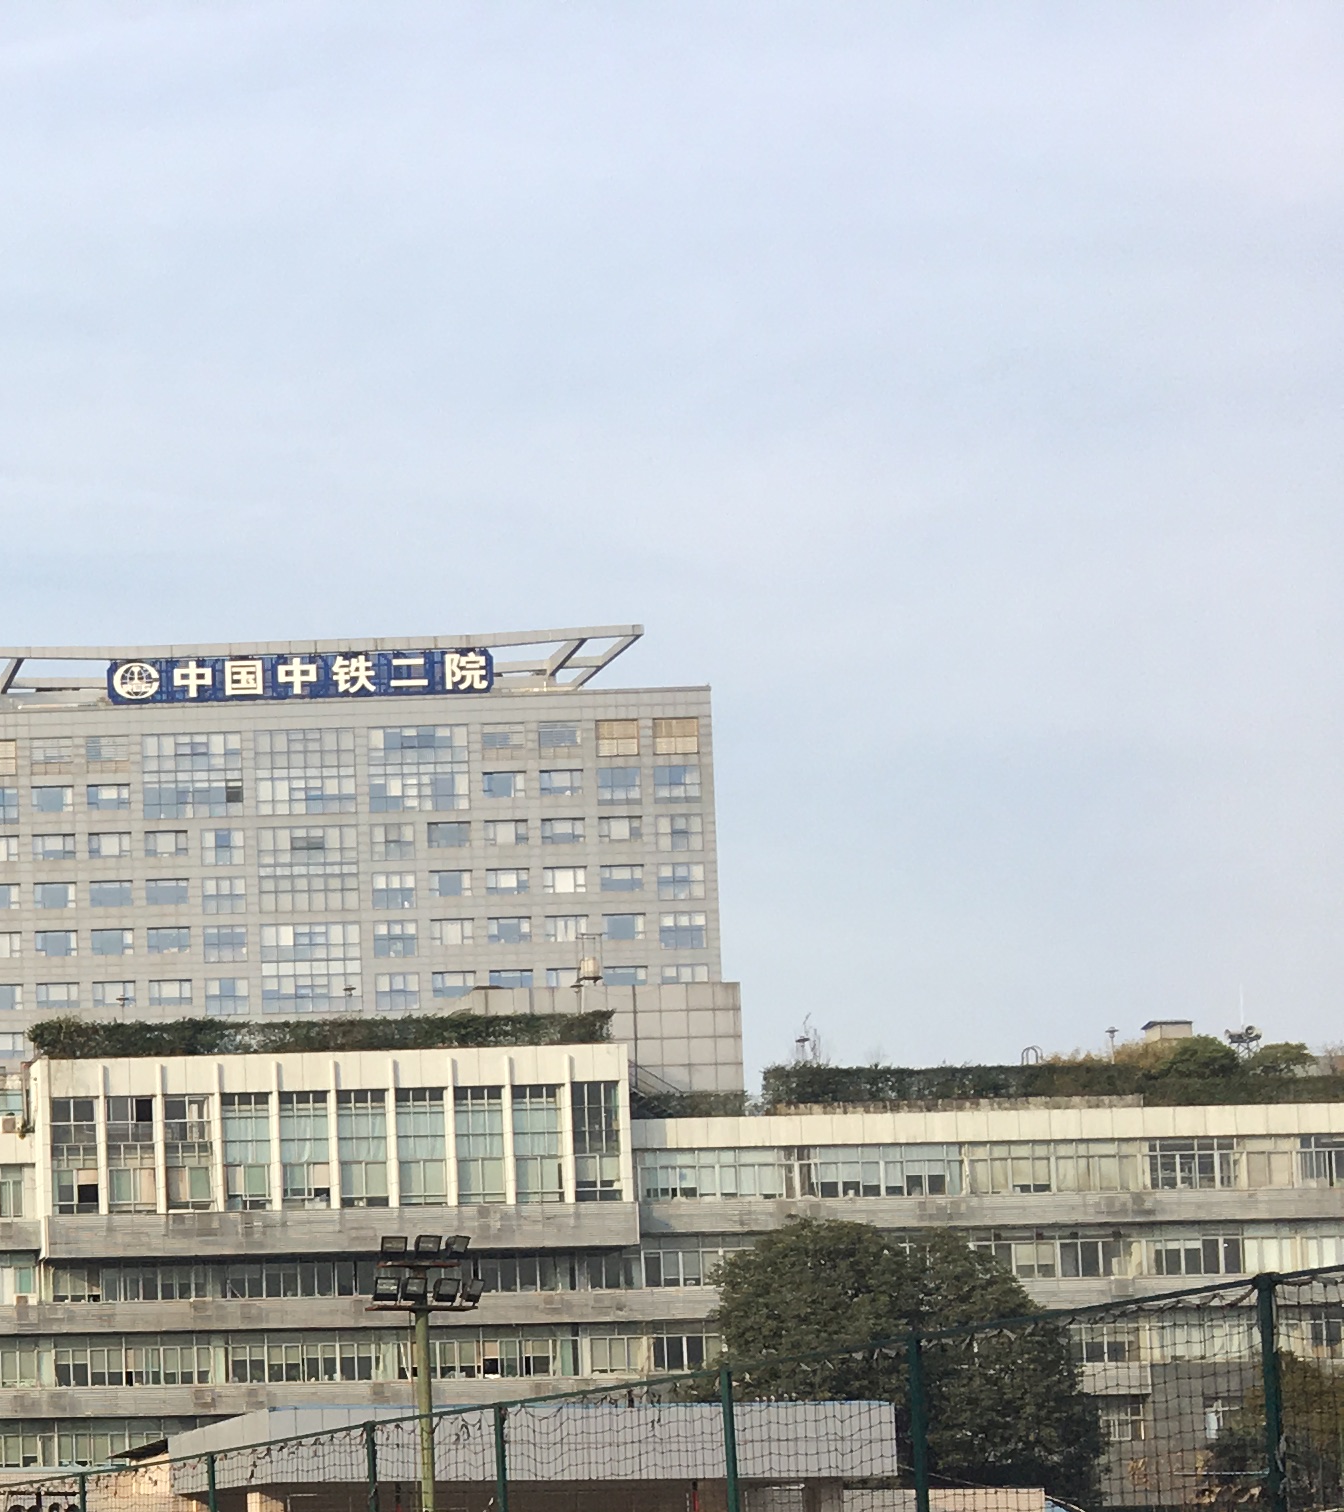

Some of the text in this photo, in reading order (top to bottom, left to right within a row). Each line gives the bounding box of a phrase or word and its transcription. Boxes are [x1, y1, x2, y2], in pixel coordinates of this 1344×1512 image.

[173, 652, 489, 698] 中国中铁二院
